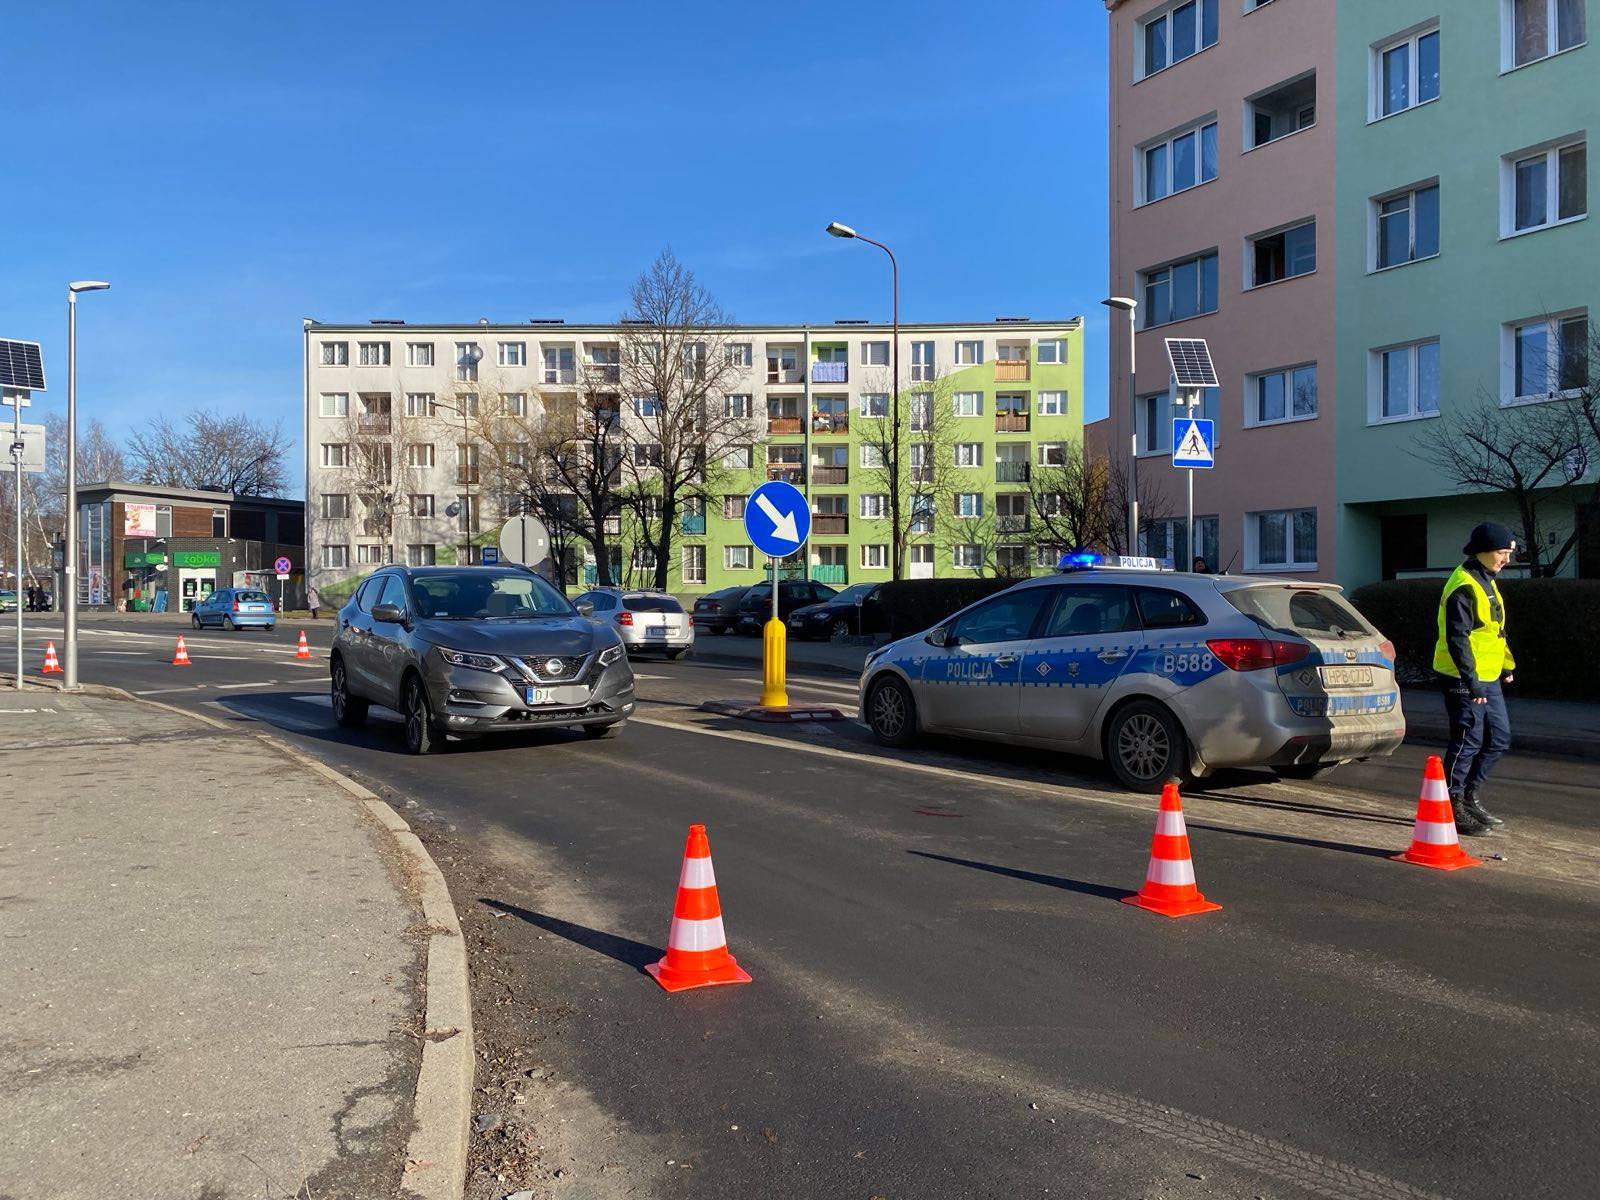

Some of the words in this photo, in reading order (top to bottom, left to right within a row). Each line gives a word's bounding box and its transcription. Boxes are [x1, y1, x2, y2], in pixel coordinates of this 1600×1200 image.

[1122, 557, 1153, 568] POLICJA
[946, 662, 994, 679] POLICJA
[1164, 653, 1213, 673] B588
